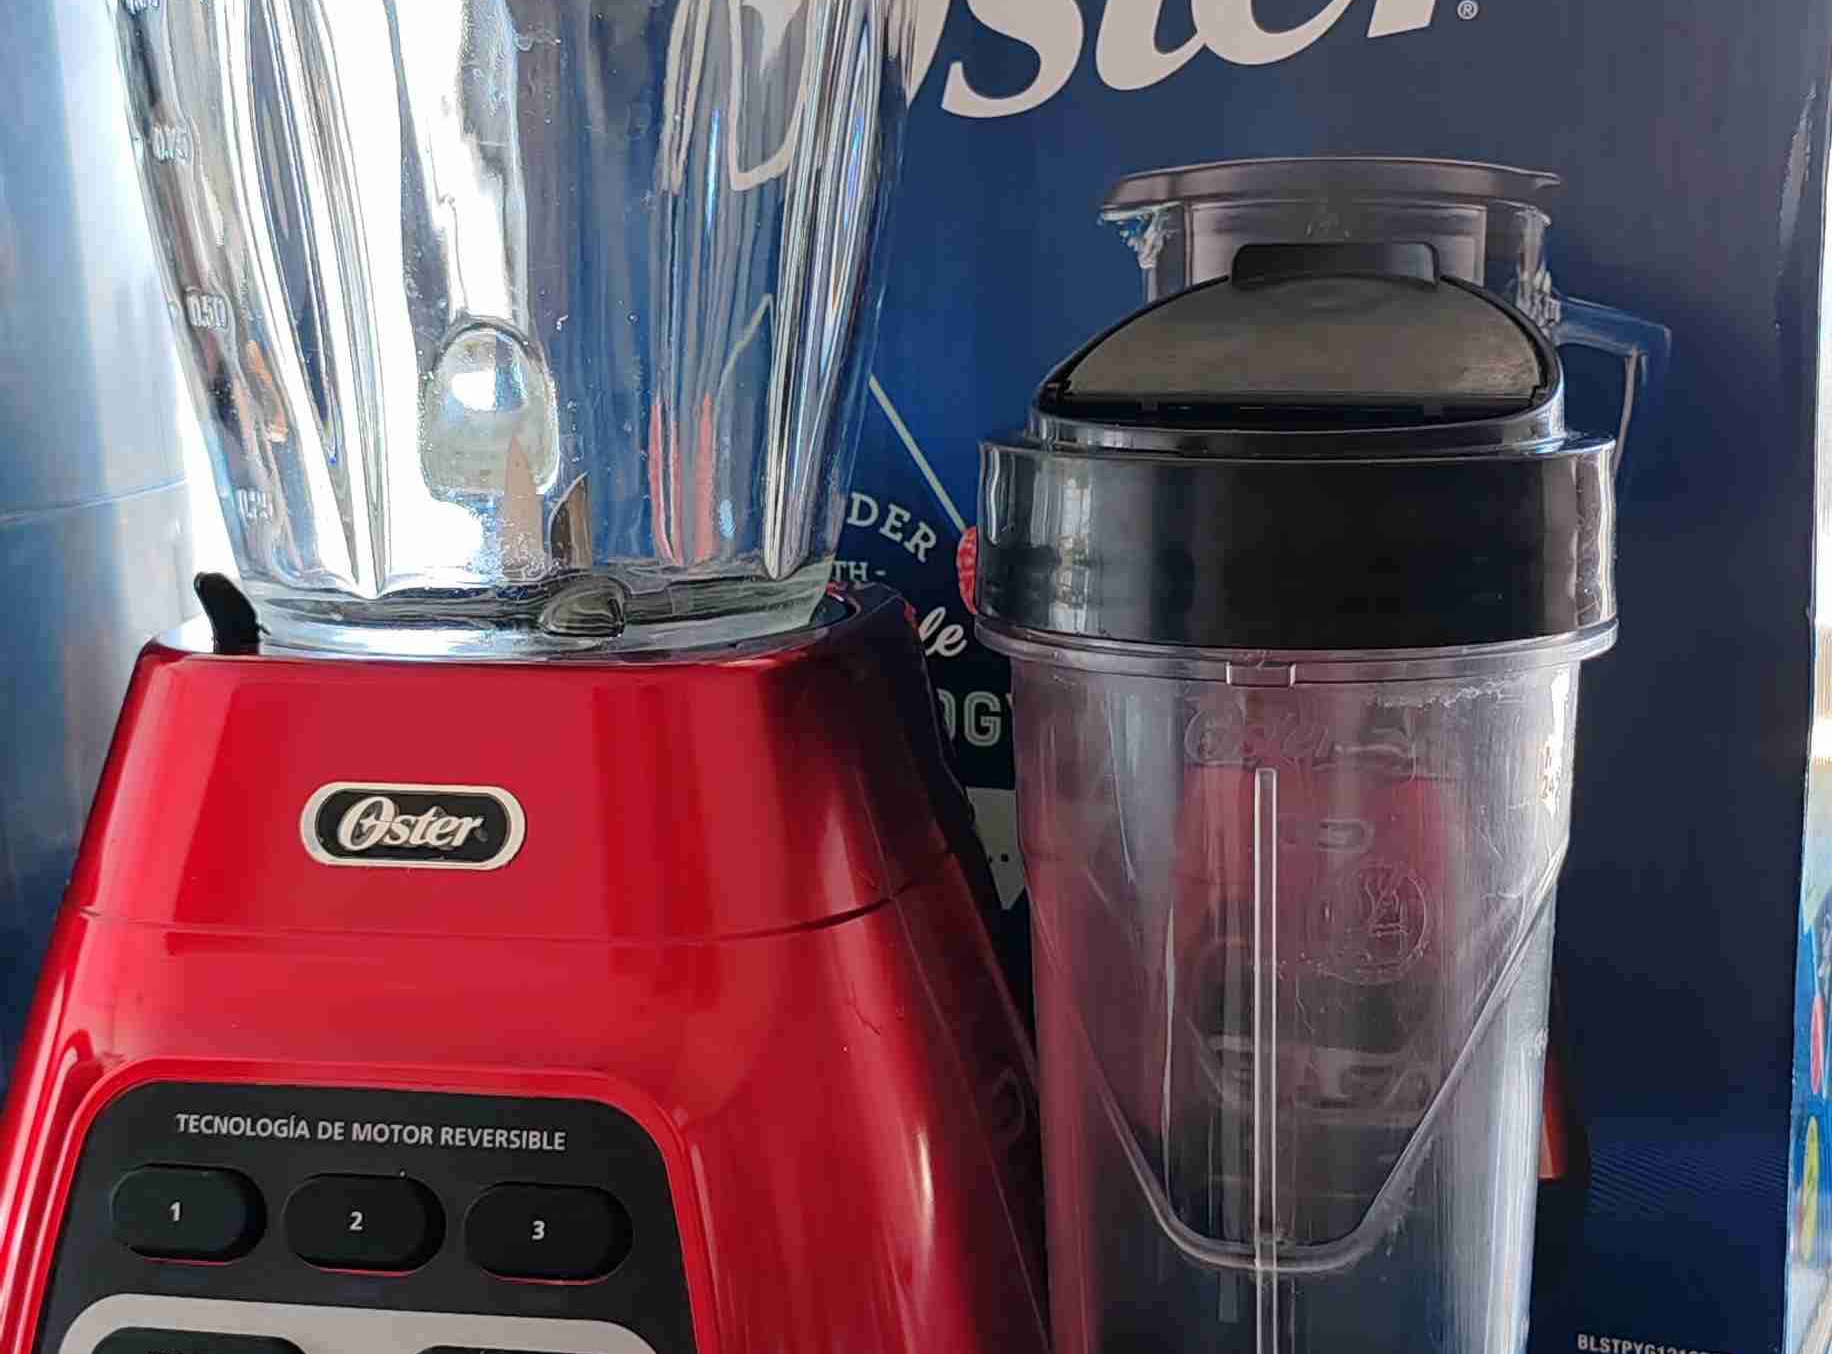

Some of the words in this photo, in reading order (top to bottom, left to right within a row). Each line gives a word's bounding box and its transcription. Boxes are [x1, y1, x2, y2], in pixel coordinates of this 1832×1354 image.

[338, 796, 485, 851] Oster
[175, 1112, 311, 1139] TECNOLOGÍA
[317, 1120, 345, 1141] DE
[351, 1122, 434, 1145] MOTOR
[440, 1126, 566, 1151] REVERSIBLE
[169, 1200, 181, 1222] 1
[349, 1211, 363, 1231] 2
[532, 1220, 545, 1240] 3
